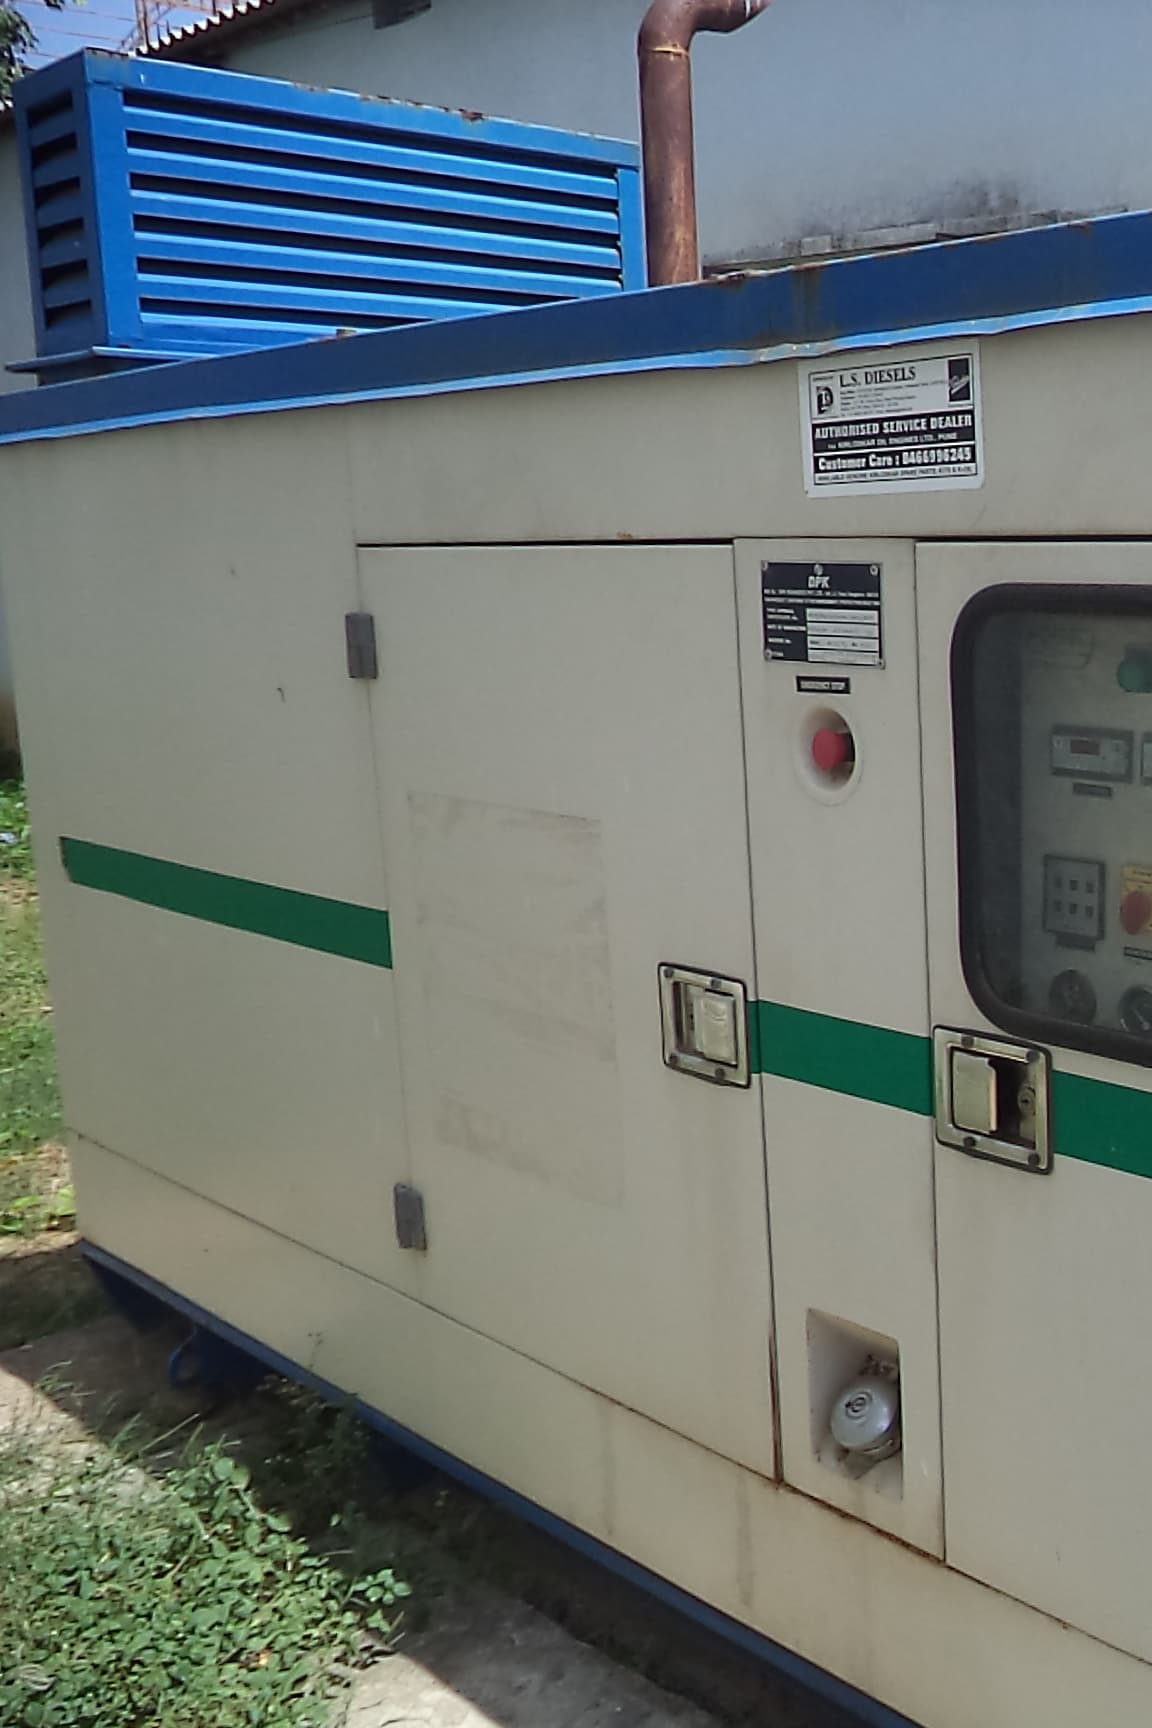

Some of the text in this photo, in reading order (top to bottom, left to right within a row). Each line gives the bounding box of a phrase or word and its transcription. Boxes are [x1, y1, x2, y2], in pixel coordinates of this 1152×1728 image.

[839, 367, 917, 387] L.S. DIESELS
[815, 414, 972, 439] AUTHORISED SERVICE DEALER
[818, 456, 867, 471] Customer
[869, 453, 893, 467] Care
[807, 576, 830, 588] DPK
